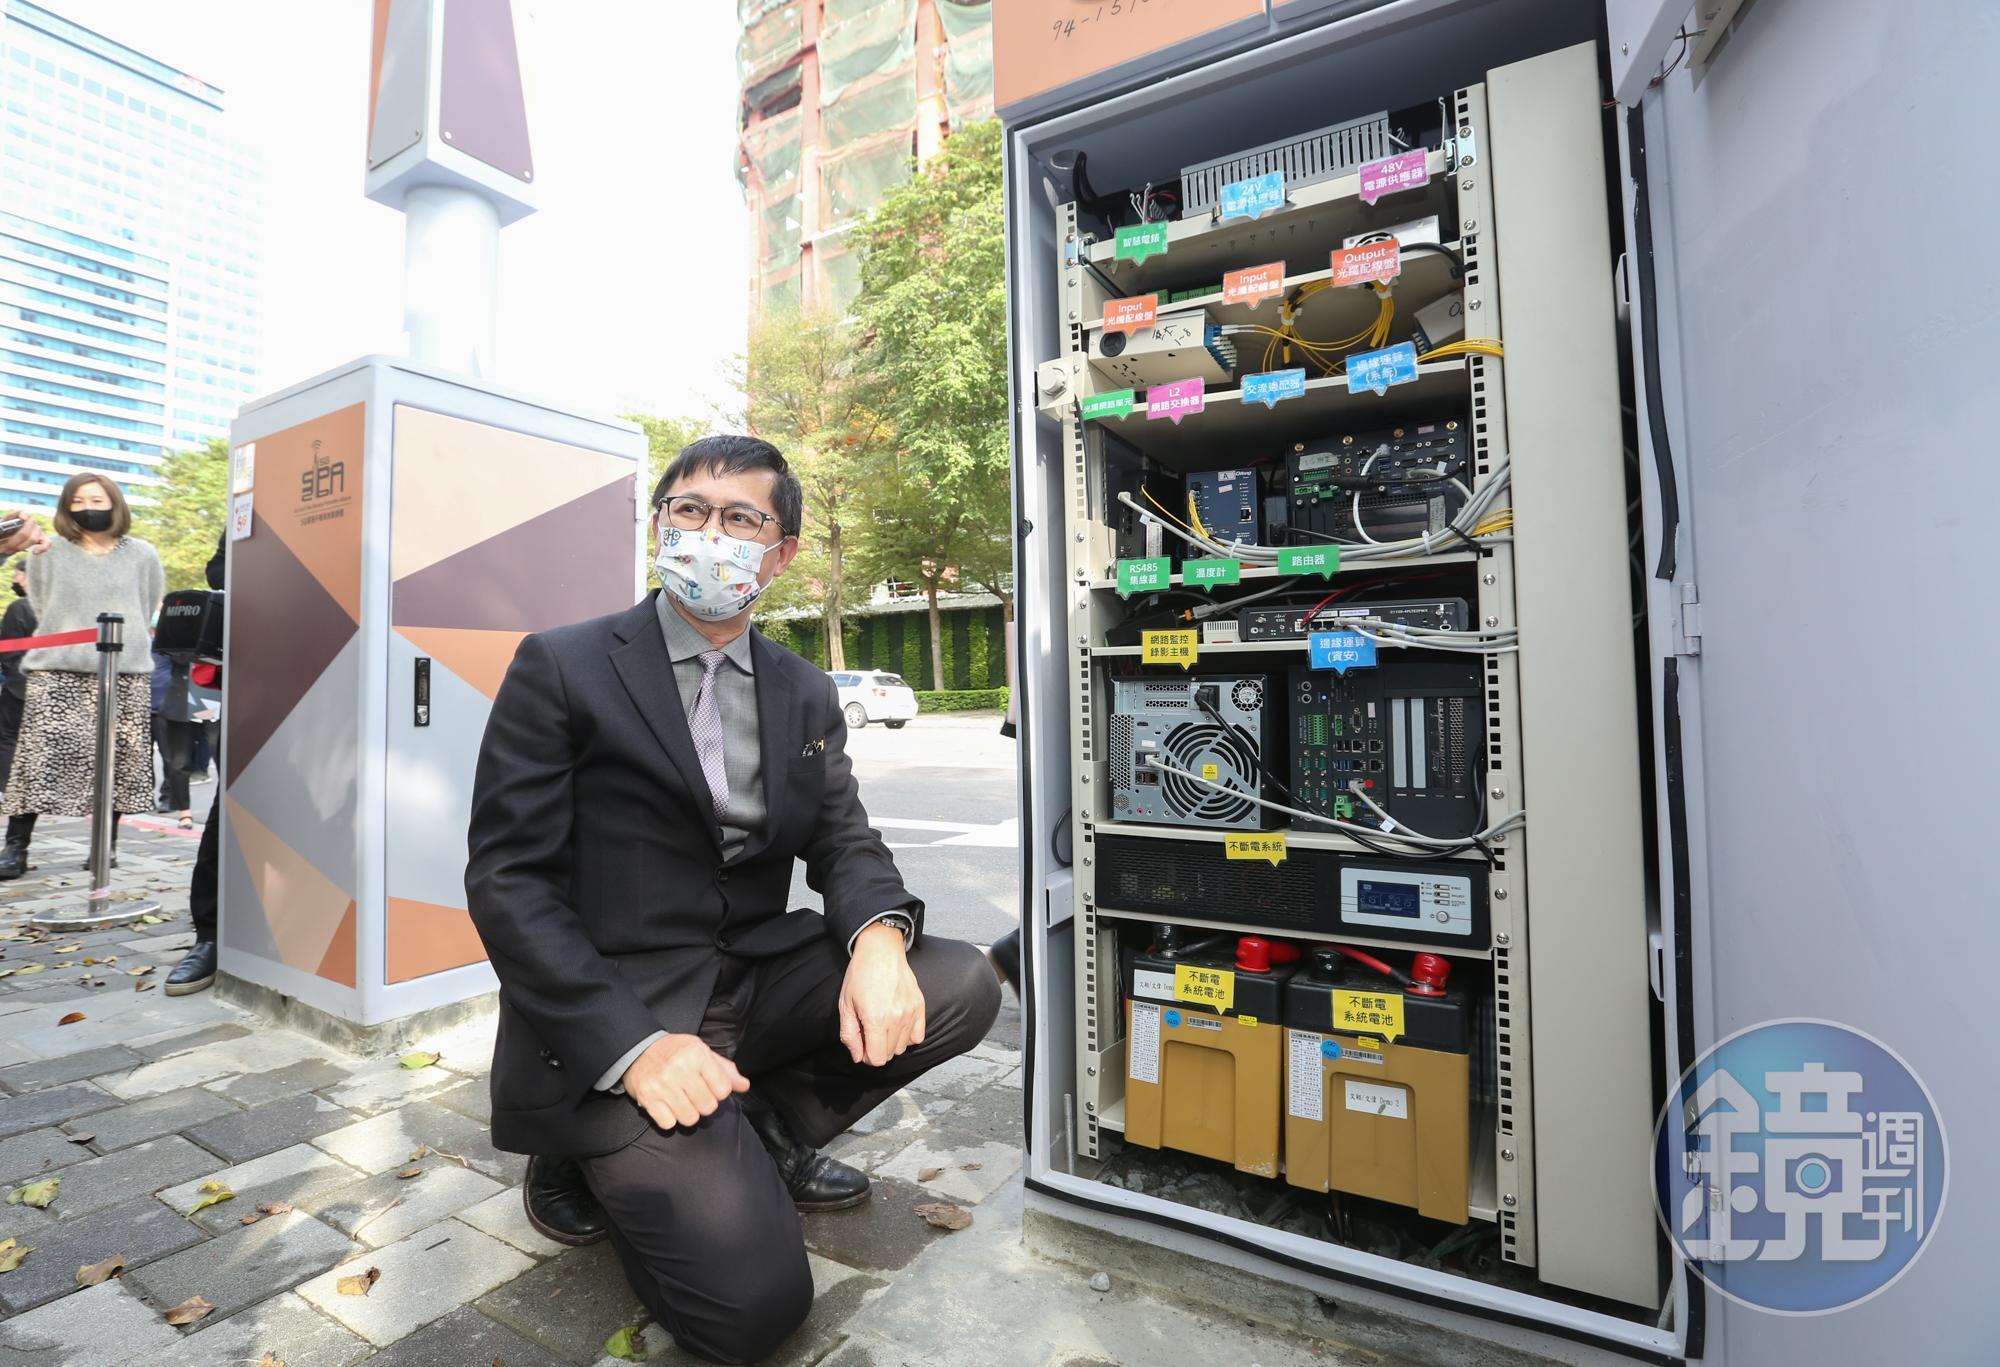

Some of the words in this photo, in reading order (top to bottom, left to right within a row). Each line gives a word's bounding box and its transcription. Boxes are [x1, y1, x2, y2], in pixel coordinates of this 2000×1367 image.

[1381, 160, 1404, 174] 48V
[1363, 167, 1424, 191] 電源供應器
[1242, 183, 1262, 197] 24V
[1344, 248, 1386, 263] Output
[1240, 271, 1267, 284] Input
[1118, 302, 1143, 313] Input
[1169, 387, 1180, 397] L2
[1151, 395, 1200, 412] 網路交換器
[1292, 554, 1325, 566] 路由器
[1129, 562, 1158, 573] RS485
[1196, 567, 1226, 578] 溫度計
[1129, 574, 1158, 585] 集線器
[166, 603, 200, 616] MIPRO
[1150, 634, 1189, 645] 網路監控
[1319, 636, 1366, 649] 邊緣運算
[1150, 647, 1189, 657] 錄影主機
[1229, 841, 1283, 852] 不斷電系統
[1189, 970, 1220, 985] 不斷電
[1183, 983, 1225, 1000] 系統電池
[1349, 996, 1387, 1010] 不斷電
[1344, 1011, 1394, 1026] 系統電池
